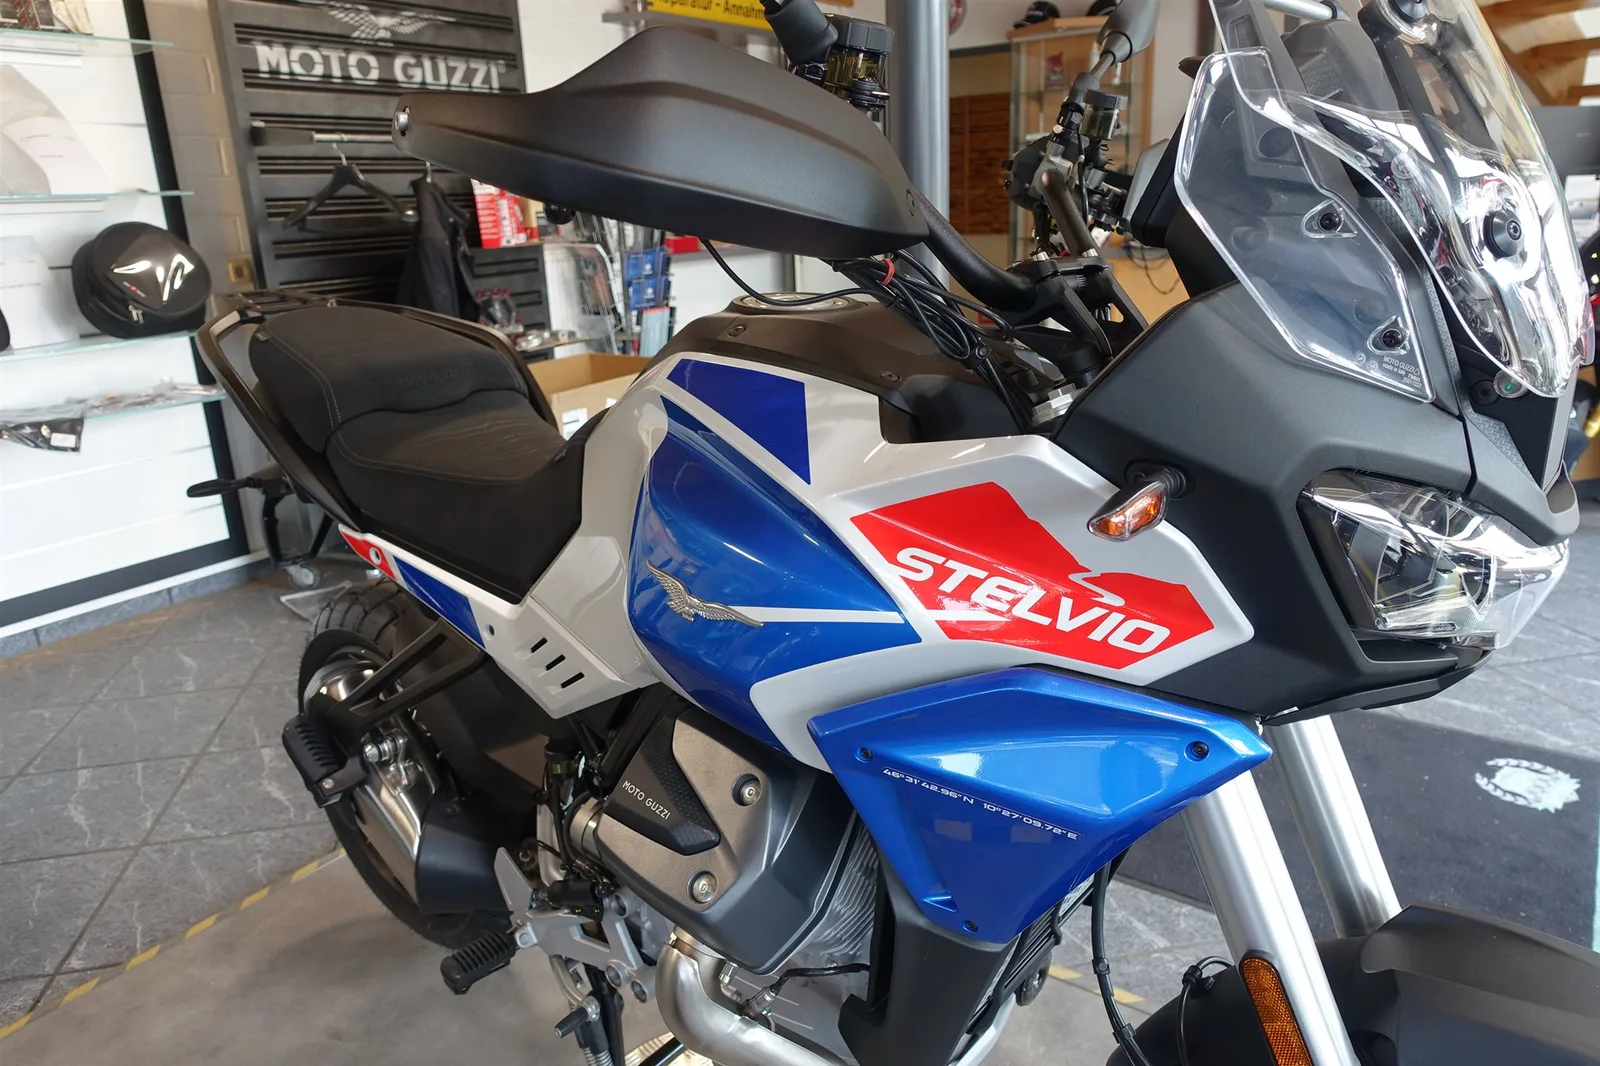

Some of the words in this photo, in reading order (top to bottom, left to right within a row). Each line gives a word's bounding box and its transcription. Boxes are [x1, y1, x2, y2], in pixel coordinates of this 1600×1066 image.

[254, 42, 380, 85] MOTO
[393, 53, 500, 93] GUZZI
[1383, 356, 1399, 366] MOTO
[896, 547, 1171, 653] STELVIO
[621, 780, 645, 801] MOTO
[645, 798, 671, 820] GUZZI
